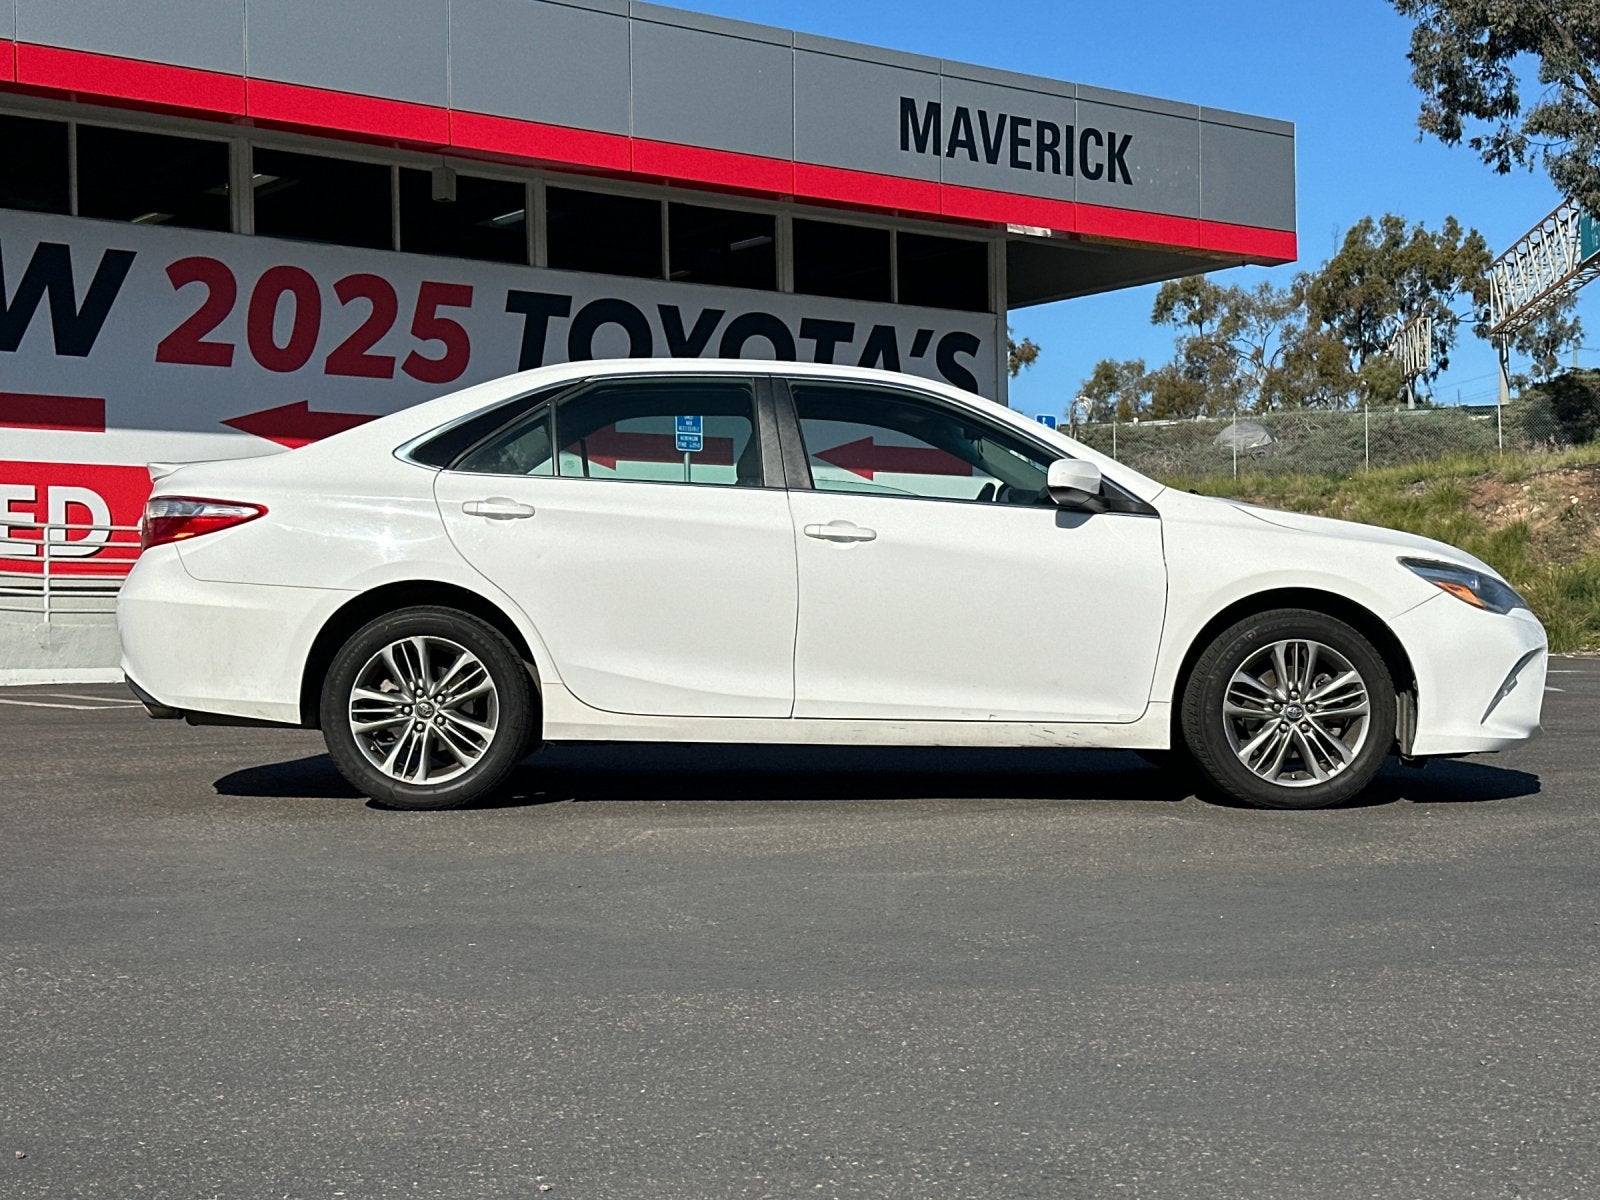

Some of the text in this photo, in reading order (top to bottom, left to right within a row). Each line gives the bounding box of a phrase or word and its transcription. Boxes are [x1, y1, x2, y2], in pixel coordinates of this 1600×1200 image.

[900, 96, 1133, 185] MAVERICK
[155, 255, 474, 384] 2025
[505, 289, 981, 395] TOYOTA'S
